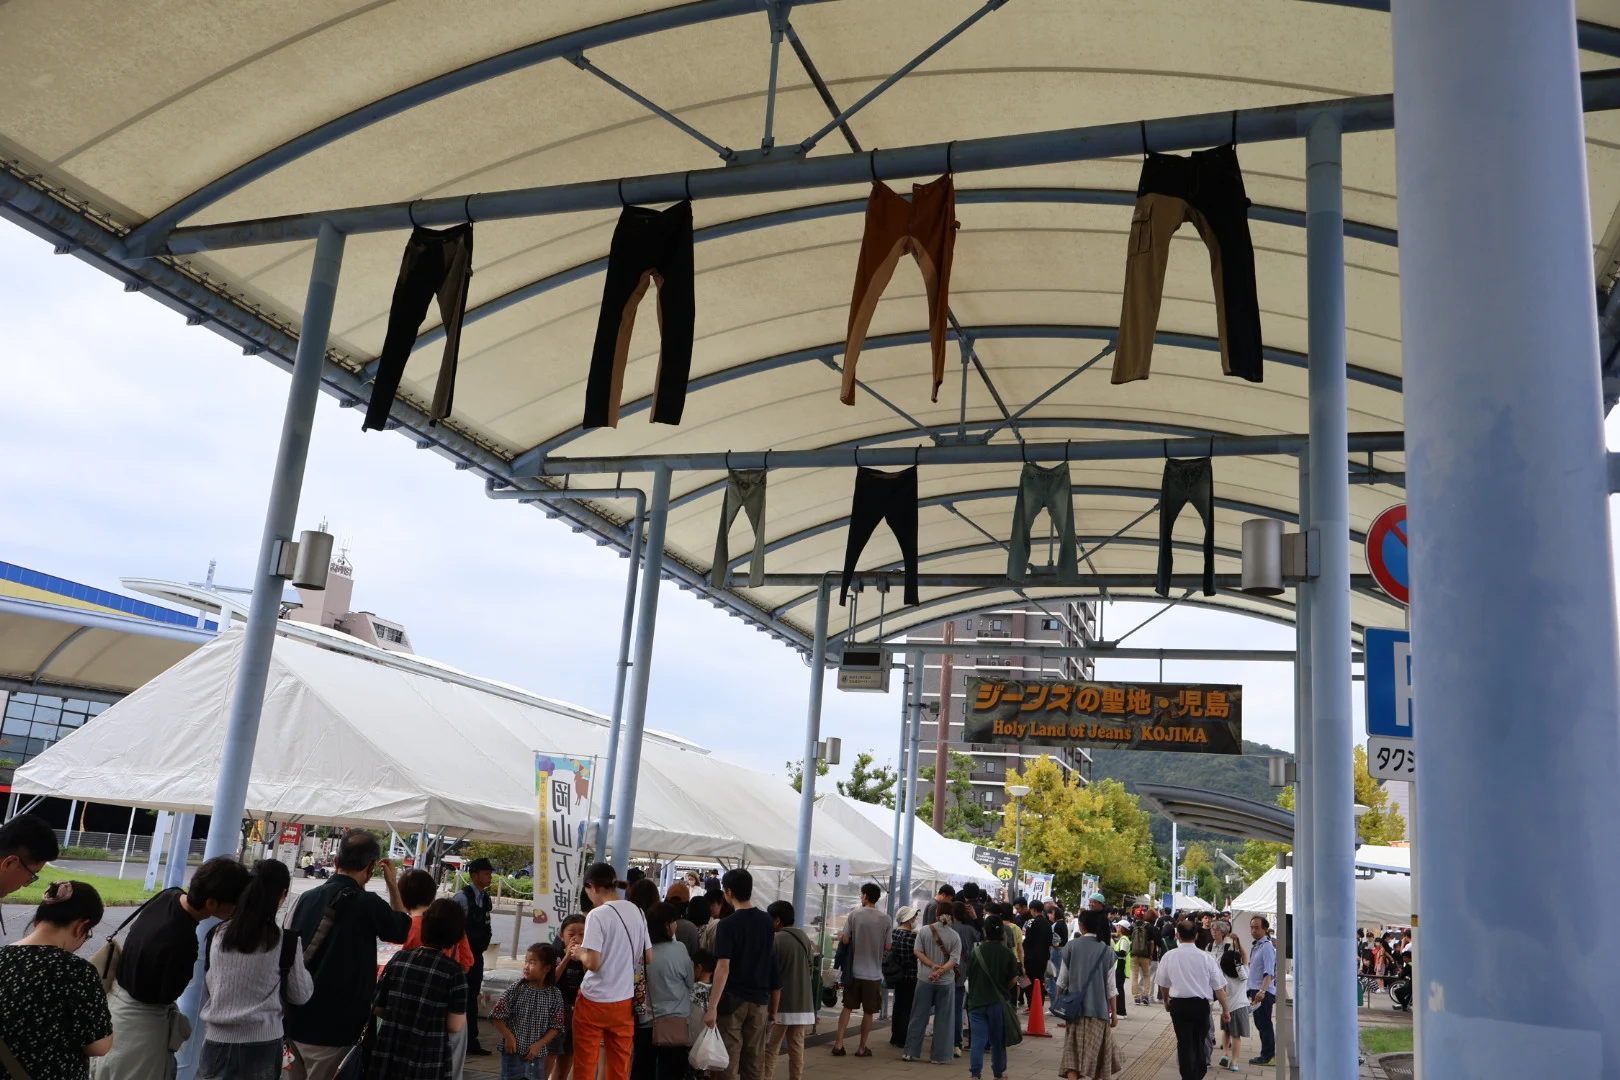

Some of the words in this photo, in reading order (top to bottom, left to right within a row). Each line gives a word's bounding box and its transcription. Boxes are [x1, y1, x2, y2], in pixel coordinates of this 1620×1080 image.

[974, 684, 1230, 718] ジーンズの聖地・児島
[992, 720, 1025, 739] Holy
[1028, 721, 1066, 738] Land
[1070, 723, 1086, 738] of
[1089, 724, 1132, 740] Jeans
[1141, 726, 1208, 743] KOJIMA
